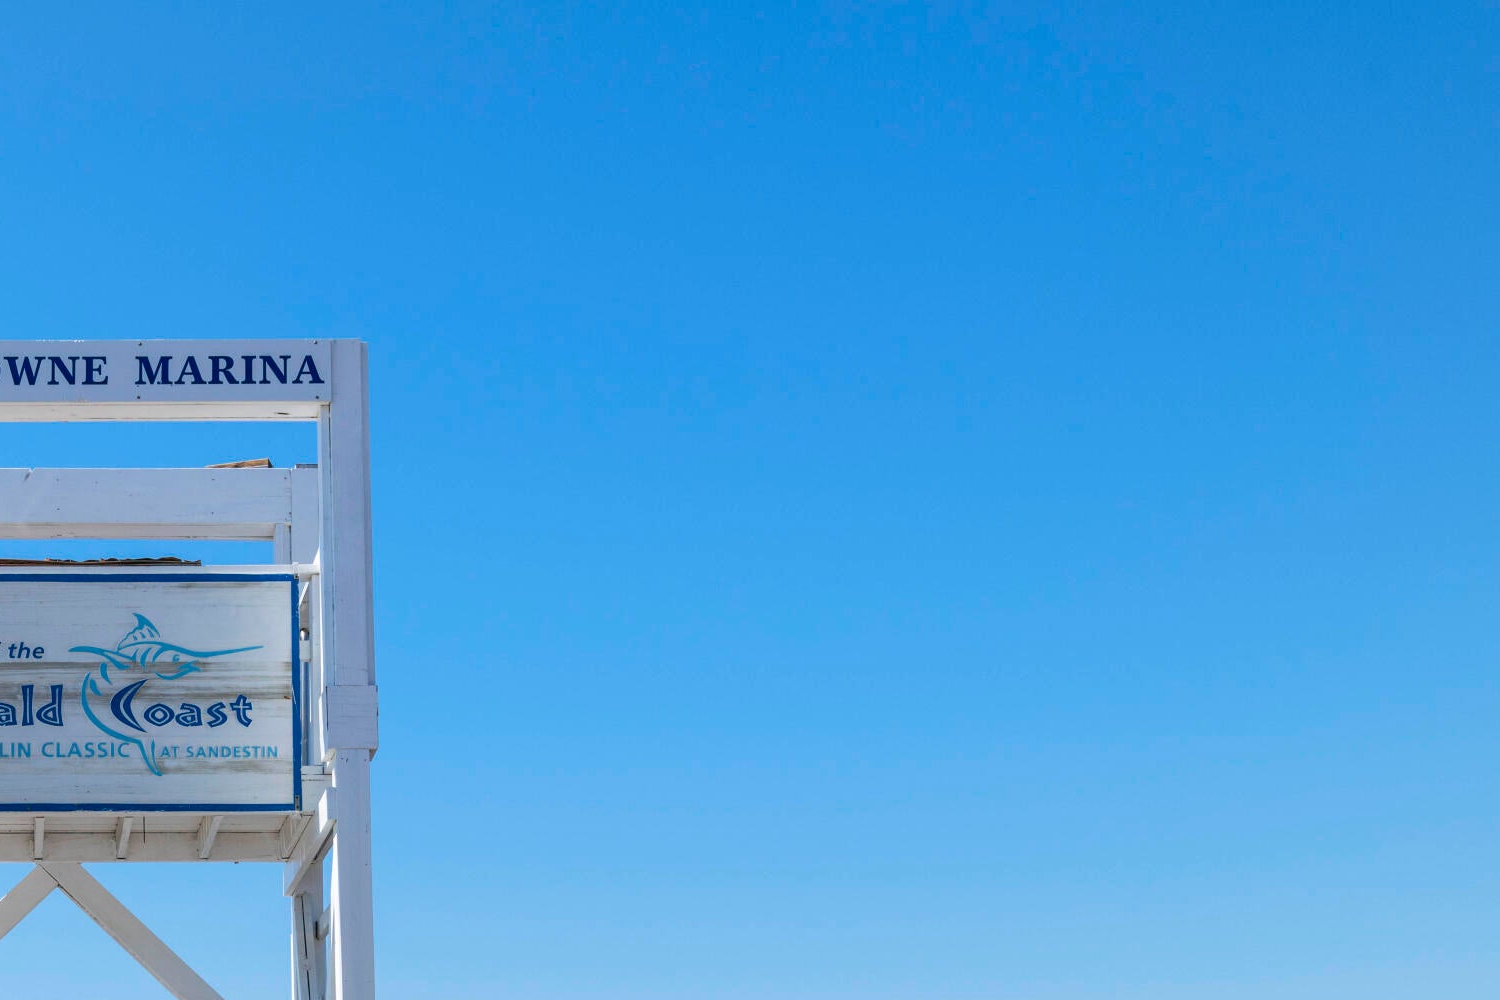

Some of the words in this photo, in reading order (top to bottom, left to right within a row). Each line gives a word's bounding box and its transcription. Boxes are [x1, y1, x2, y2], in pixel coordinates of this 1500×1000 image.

[134, 355, 325, 385] MARINA
[8, 642, 45, 659] the
[110, 678, 253, 733] Coast
[41, 741, 130, 758] CLASSIC
[160, 746, 180, 758] AT
[187, 745, 278, 758] SANDESTIN
